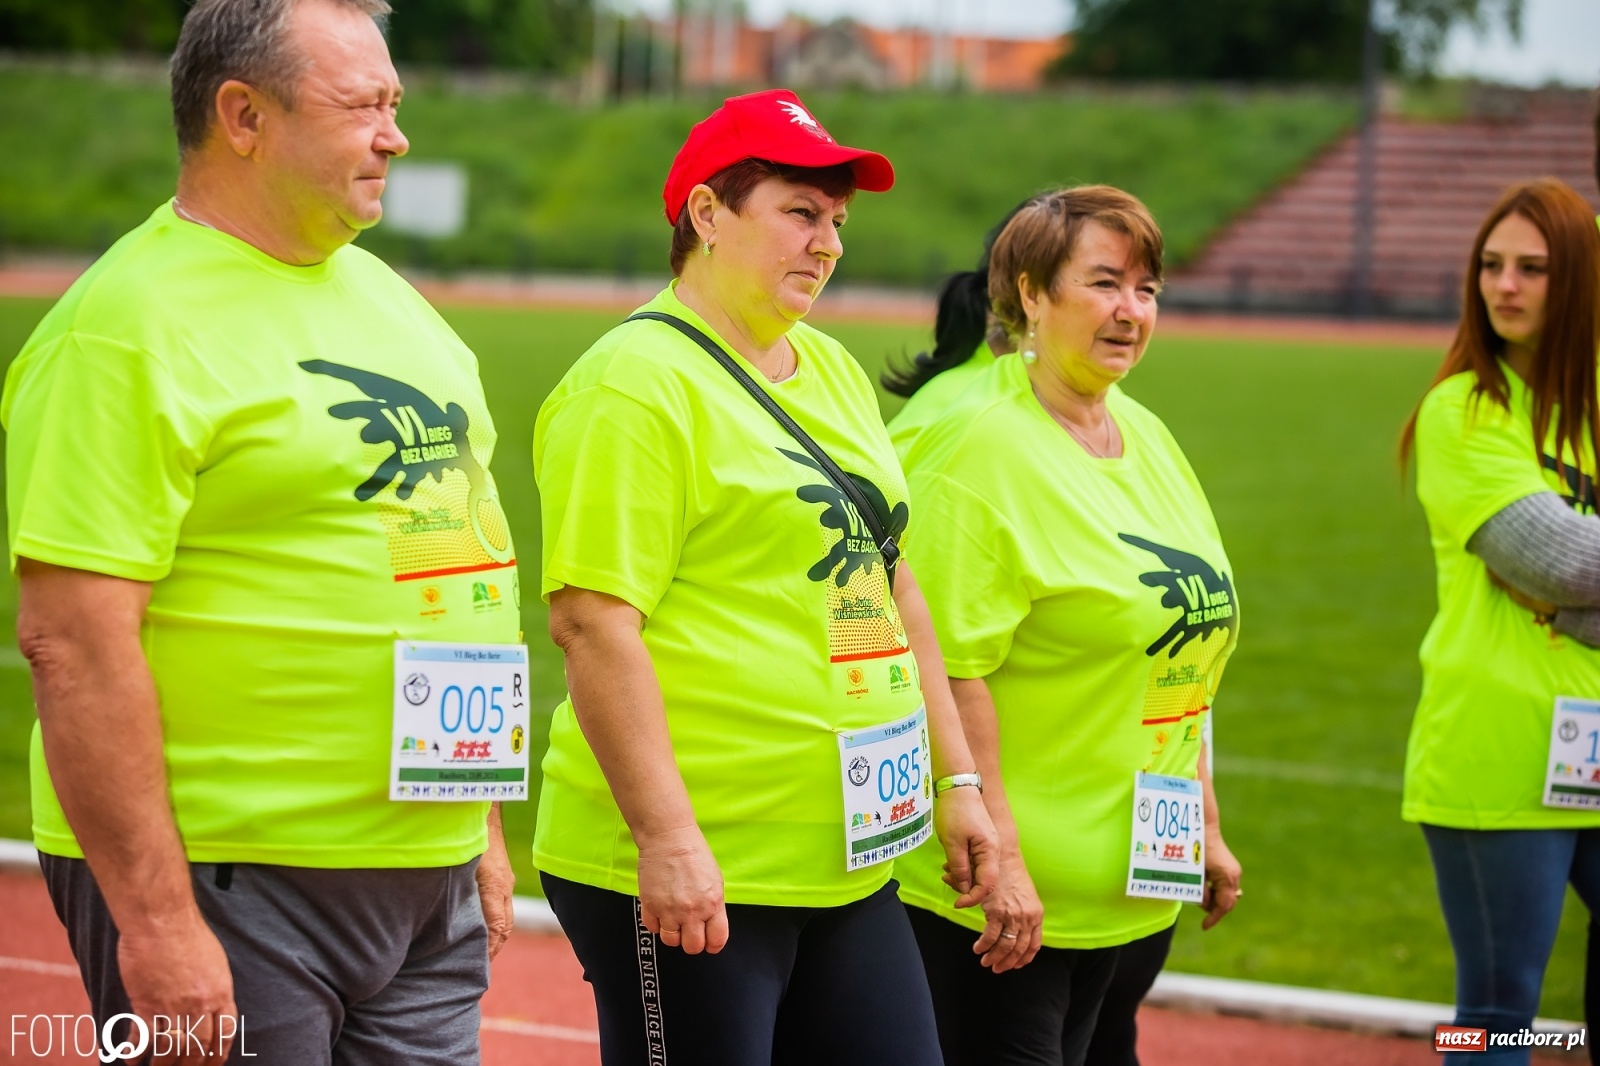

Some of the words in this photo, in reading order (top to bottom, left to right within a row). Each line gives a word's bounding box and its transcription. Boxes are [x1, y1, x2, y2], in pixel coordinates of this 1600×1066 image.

[380, 405, 429, 446] VI
[427, 425, 453, 444] BIEG
[400, 447, 424, 465] BEZ
[421, 443, 460, 462] BARIER
[839, 498, 868, 537] VI
[846, 538, 861, 552] BEZ
[1176, 573, 1211, 611] VI
[1209, 590, 1229, 607] BIEG
[1187, 610, 1203, 626] BEZ
[1203, 604, 1233, 622] BARIER
[440, 685, 504, 734] 005
[891, 726, 902, 735] Bieg
[877, 746, 920, 803] 085
[1155, 799, 1190, 840] 084
[642, 960, 656, 998] NICE
[646, 1002, 661, 1039] NICE
